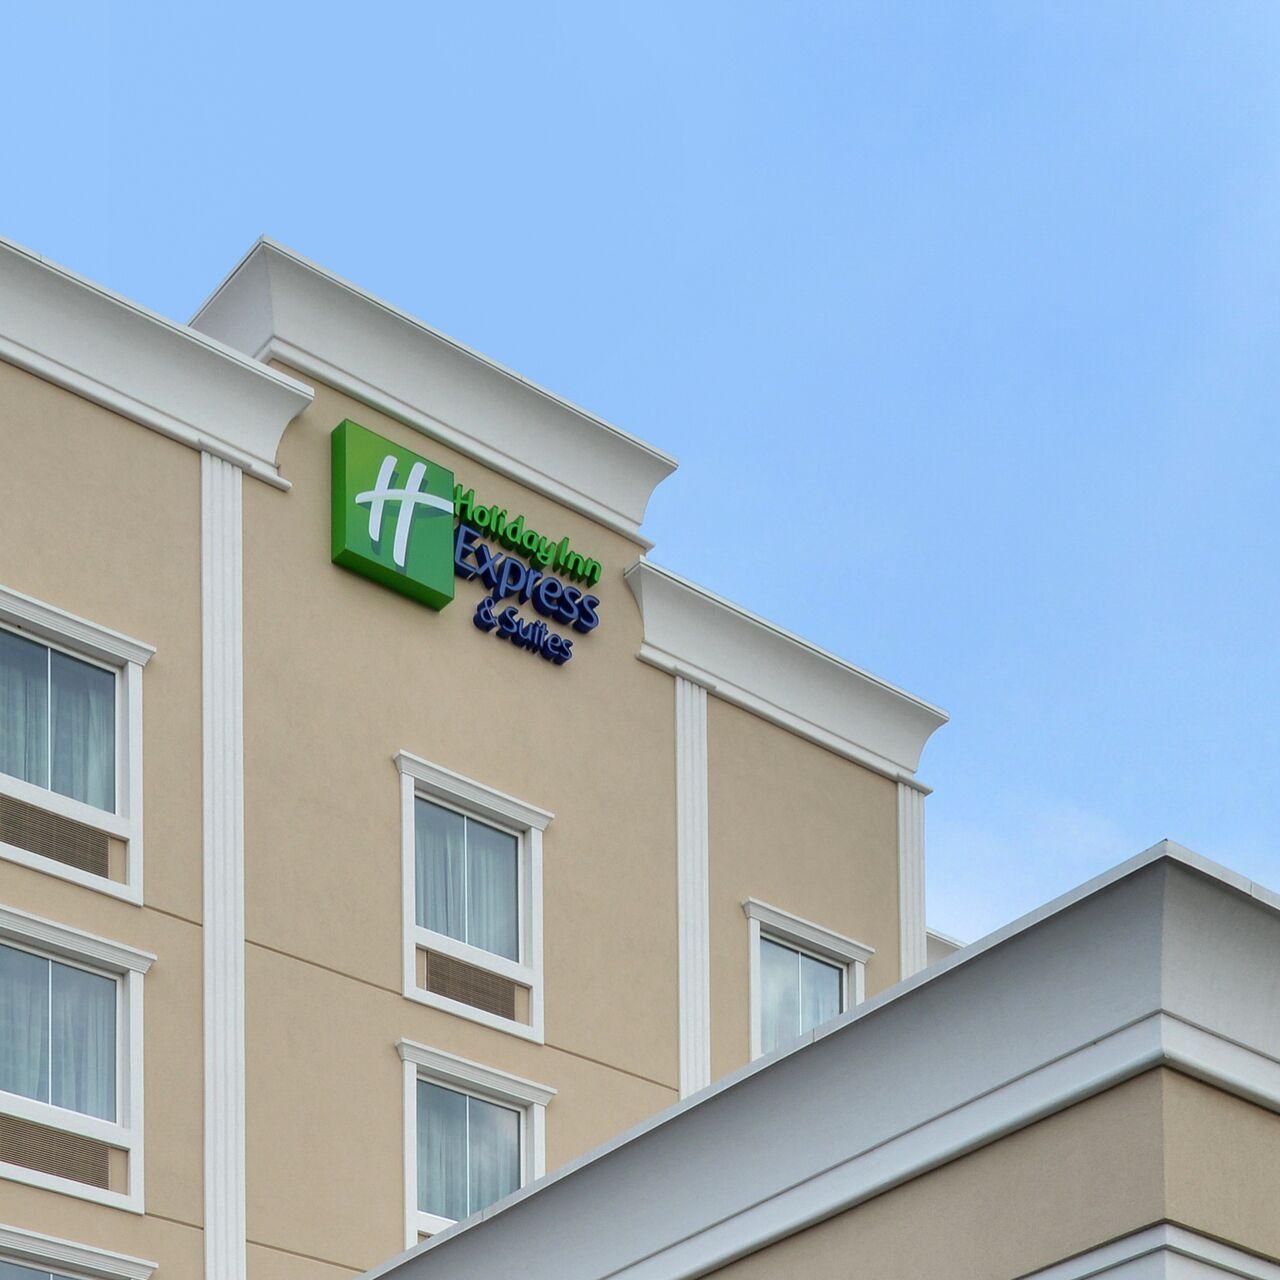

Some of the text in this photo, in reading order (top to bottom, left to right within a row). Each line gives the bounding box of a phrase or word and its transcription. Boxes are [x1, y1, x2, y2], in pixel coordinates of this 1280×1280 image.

[453, 483, 602, 588] Holiday Inn
[454, 523, 600, 634] Express
[473, 596, 573, 666] & Suites
